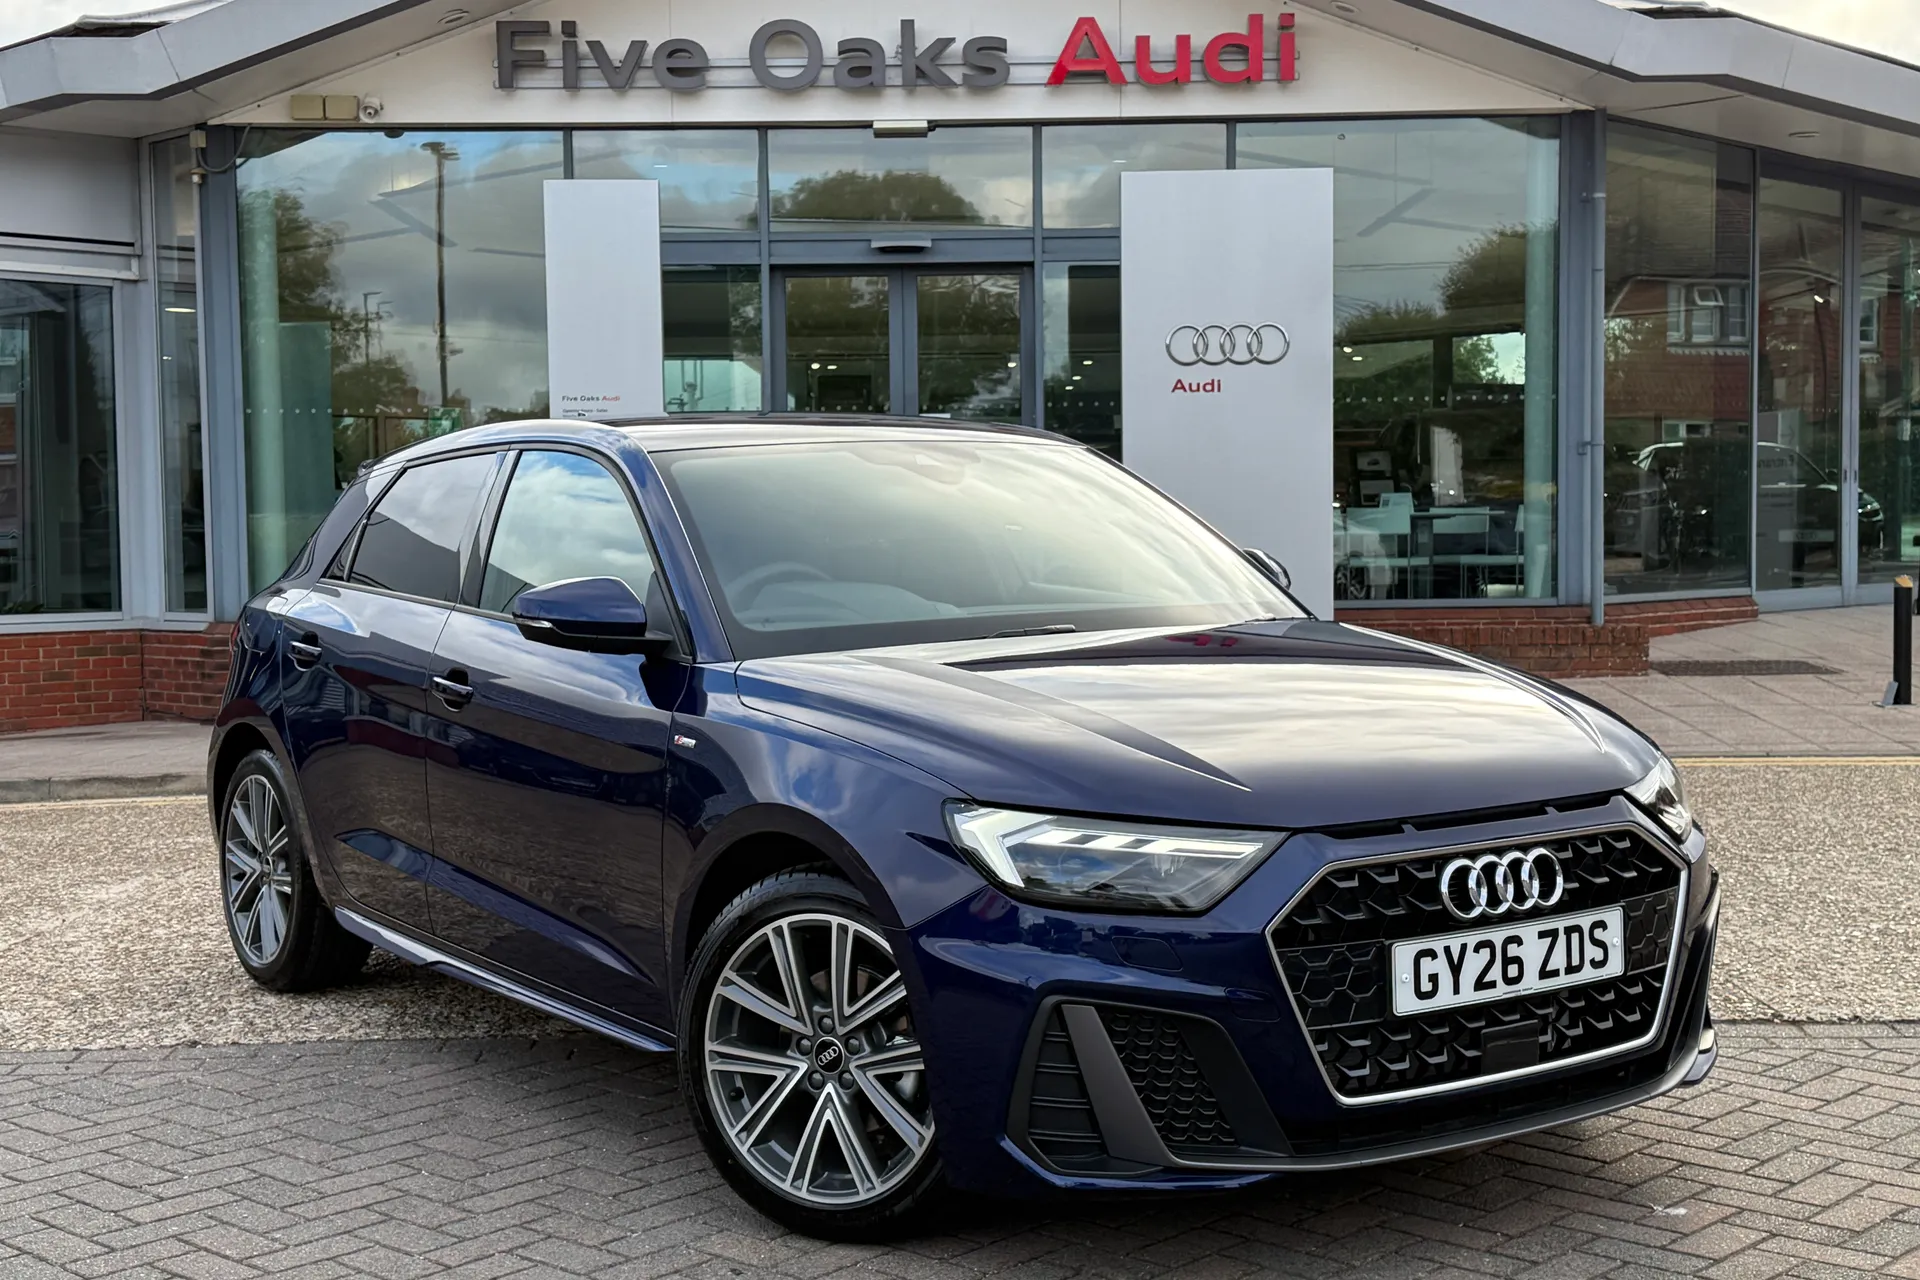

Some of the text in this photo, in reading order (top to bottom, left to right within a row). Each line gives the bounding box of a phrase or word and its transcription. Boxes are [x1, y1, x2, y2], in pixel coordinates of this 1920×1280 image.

[496, 13, 1296, 92] Five Oaks Audi
[1171, 378, 1222, 393] Audi
[1413, 919, 1609, 1001] GY26 ZDS
